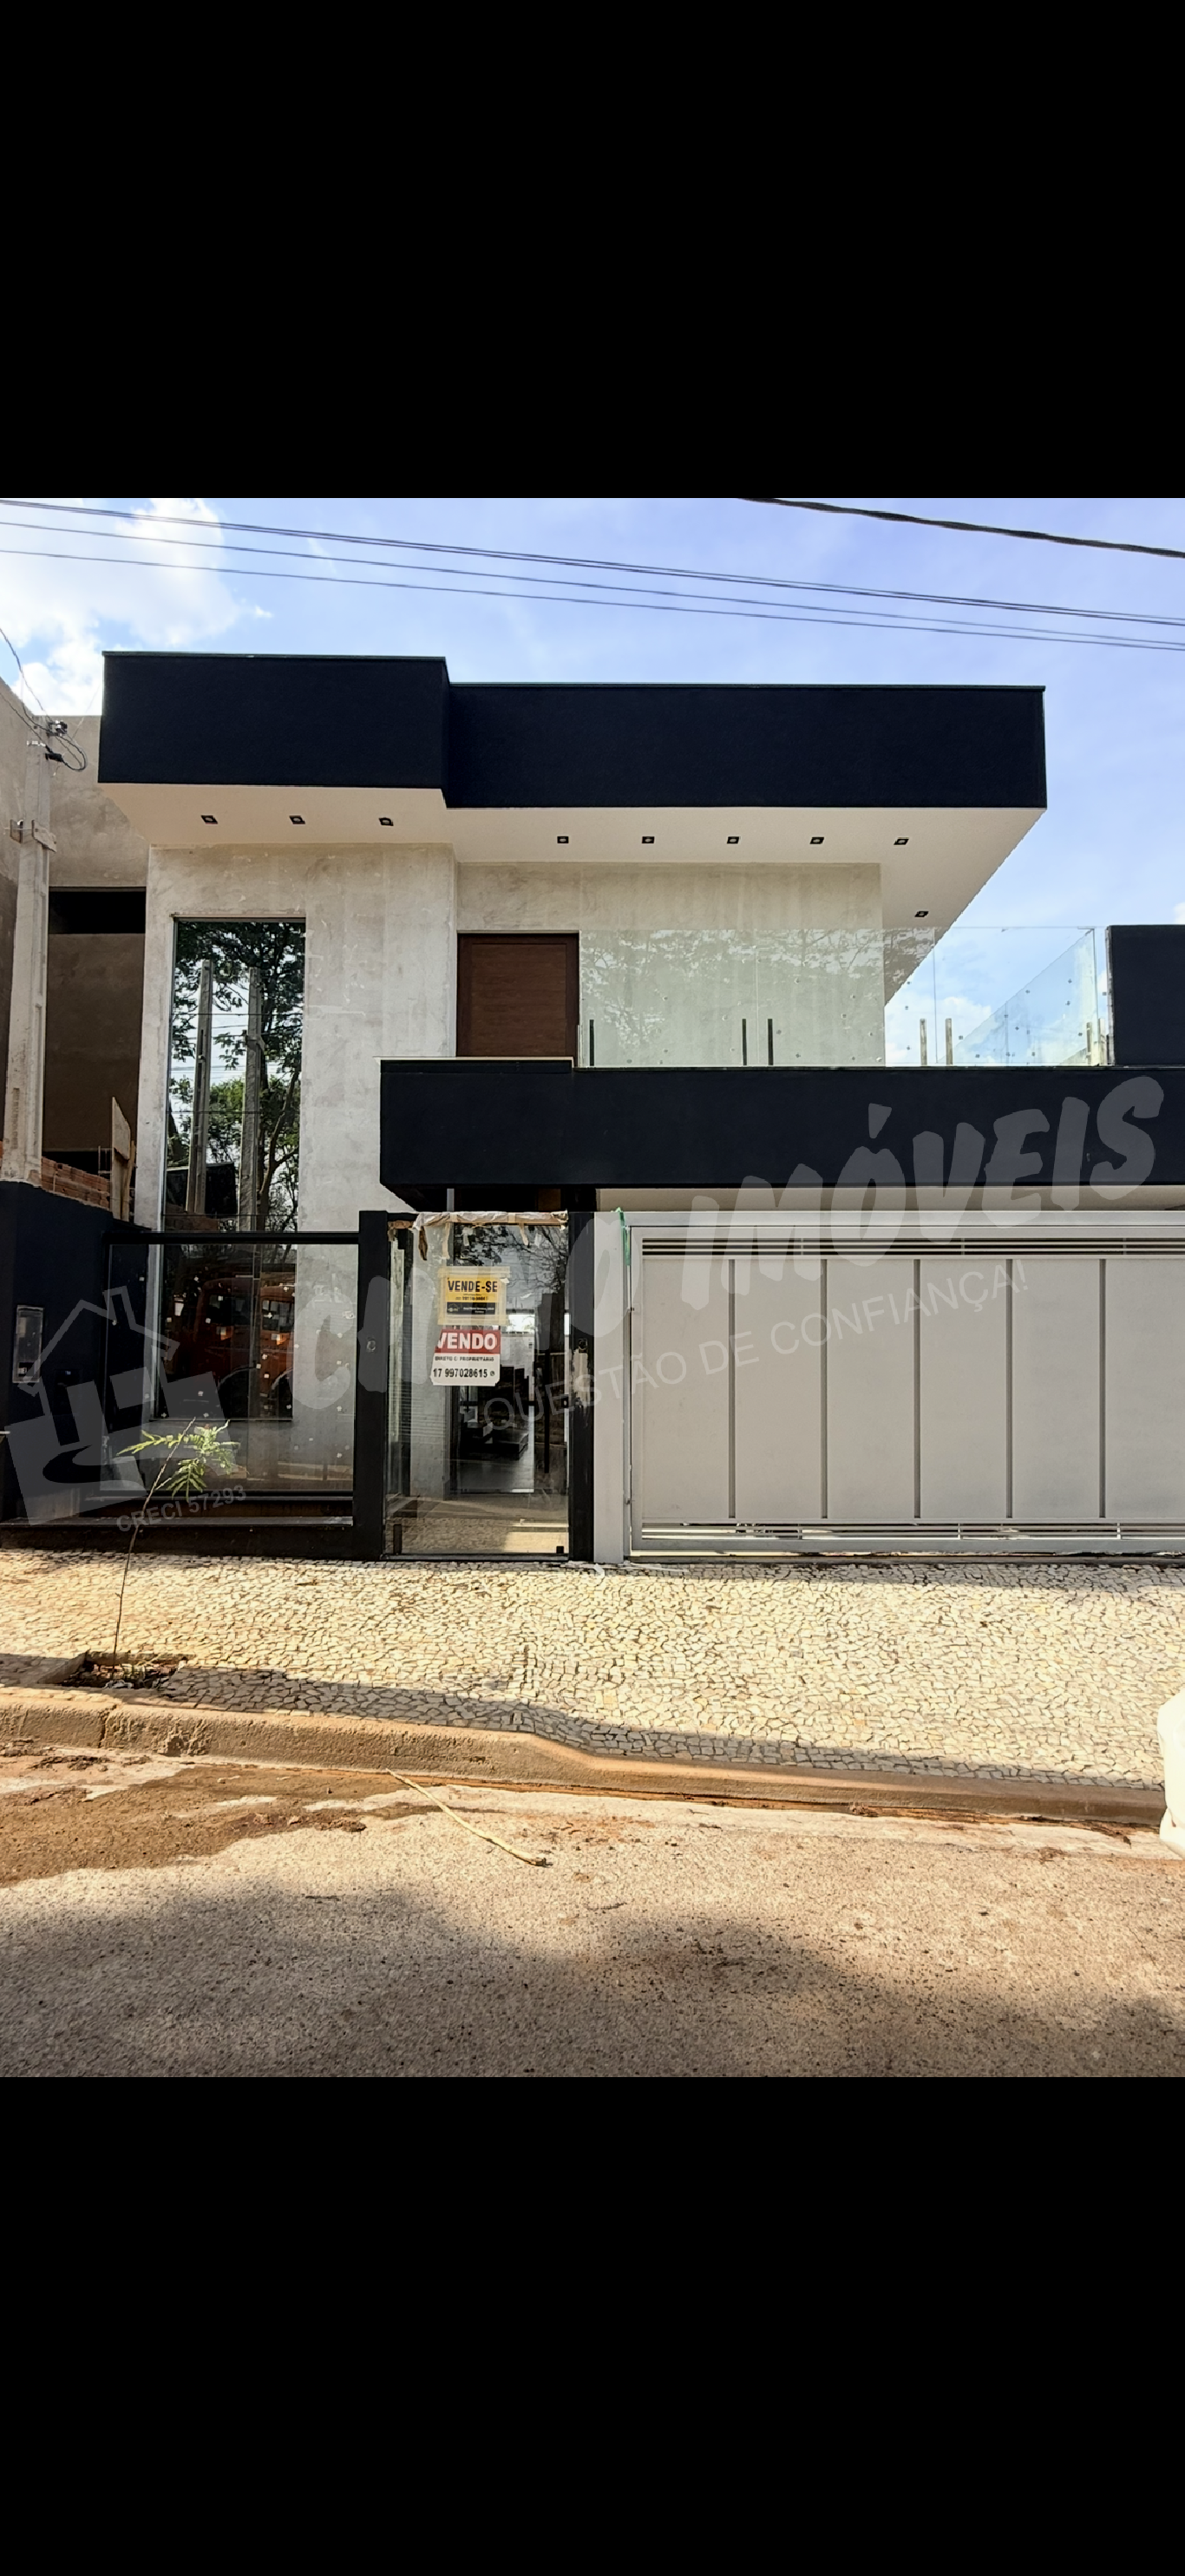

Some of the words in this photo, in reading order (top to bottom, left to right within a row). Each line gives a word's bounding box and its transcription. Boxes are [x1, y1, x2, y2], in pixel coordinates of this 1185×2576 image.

[448, 1281, 498, 1293] VENDE-SE
[437, 1332, 497, 1351] VENDO
[433, 1368, 442, 1378] 17
